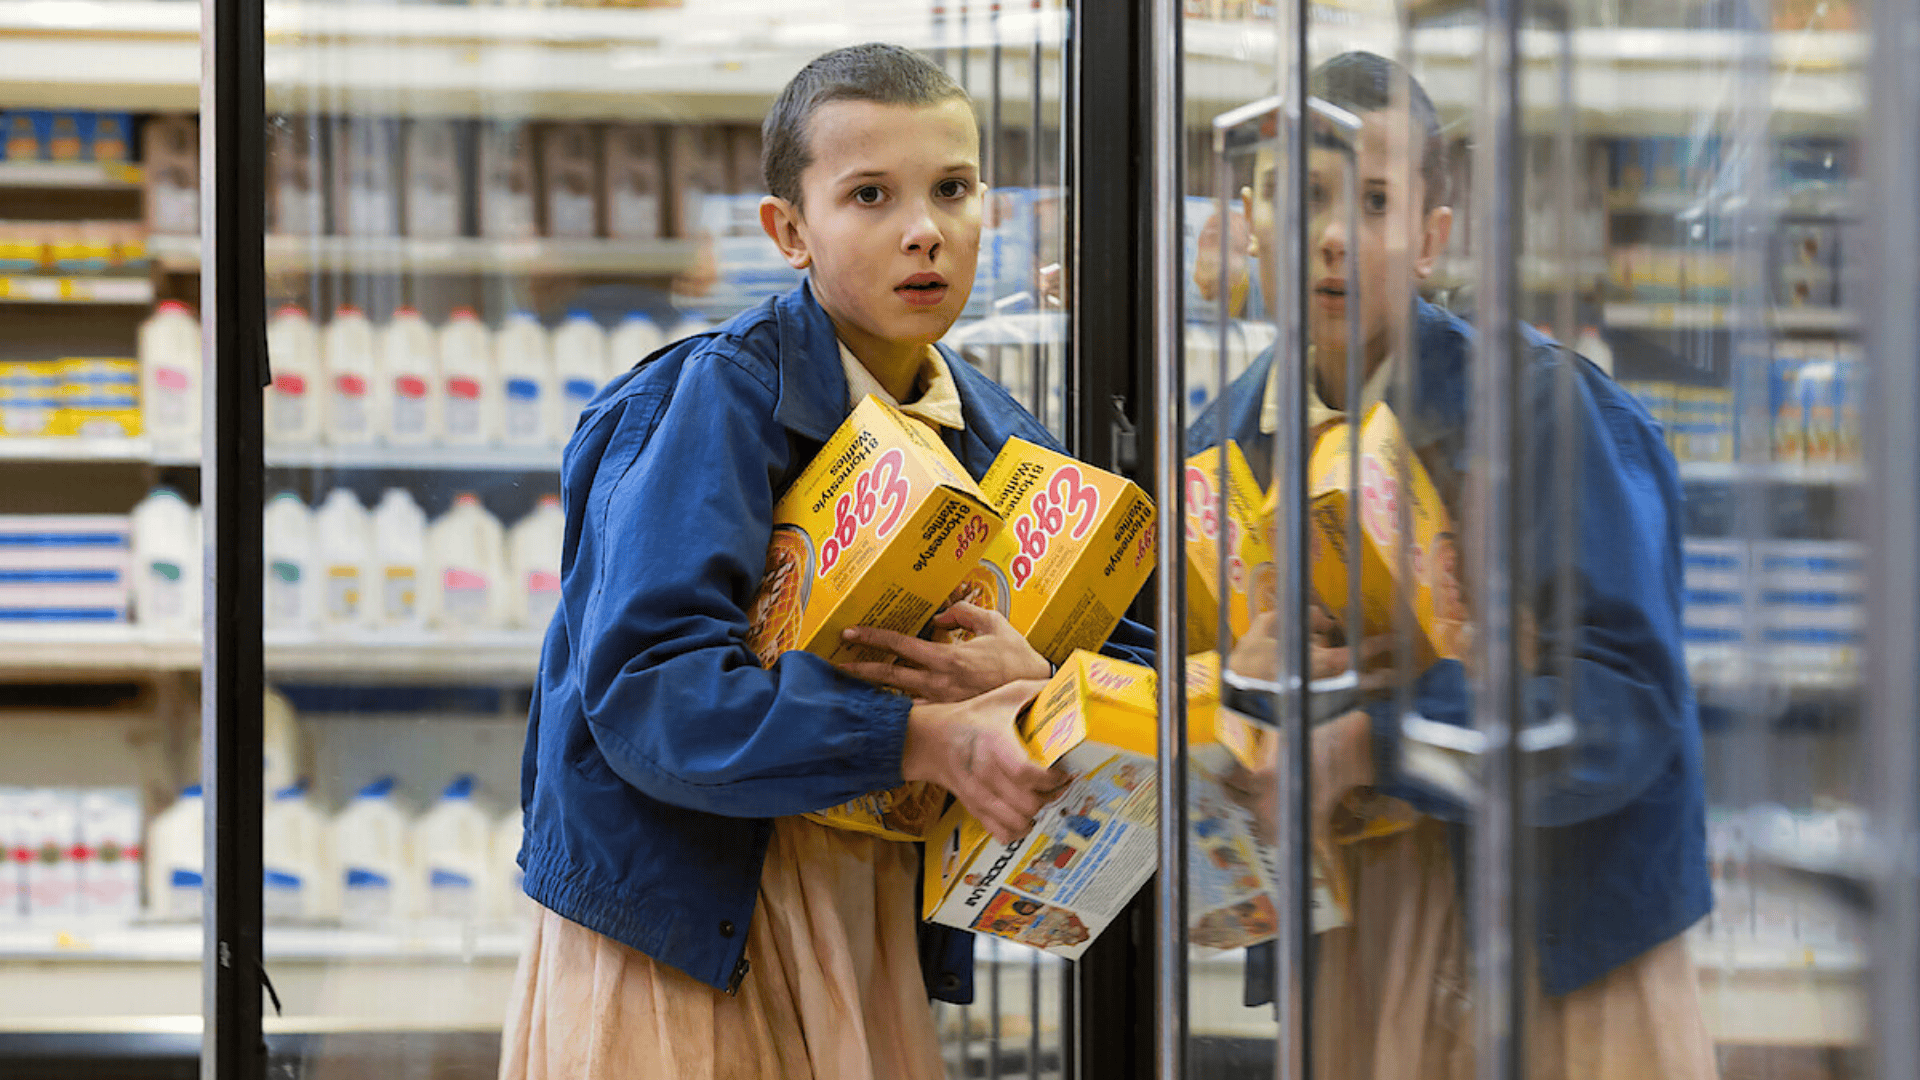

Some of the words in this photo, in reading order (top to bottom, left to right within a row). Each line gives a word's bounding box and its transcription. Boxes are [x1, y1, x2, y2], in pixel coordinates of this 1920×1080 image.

[829, 430, 872, 476] Waffles
[869, 438, 879, 448] 8
[812, 446, 871, 513] Homestyle
[994, 462, 1032, 507] Waffles
[1033, 464, 1044, 475] 8
[818, 448, 910, 578] Eggo
[960, 505, 970, 515] 8
[1000, 473, 1038, 520] Homes
[1143, 507, 1151, 517] 8
[913, 512, 965, 572] Homestyle
[923, 500, 960, 540] Waffles
[955, 515, 989, 561] Eggo
[1010, 464, 1099, 590] Eggo
[1115, 500, 1145, 541] Waffles
[1104, 515, 1146, 577] Homestyle
[965, 837, 1025, 906] INTRODUC
